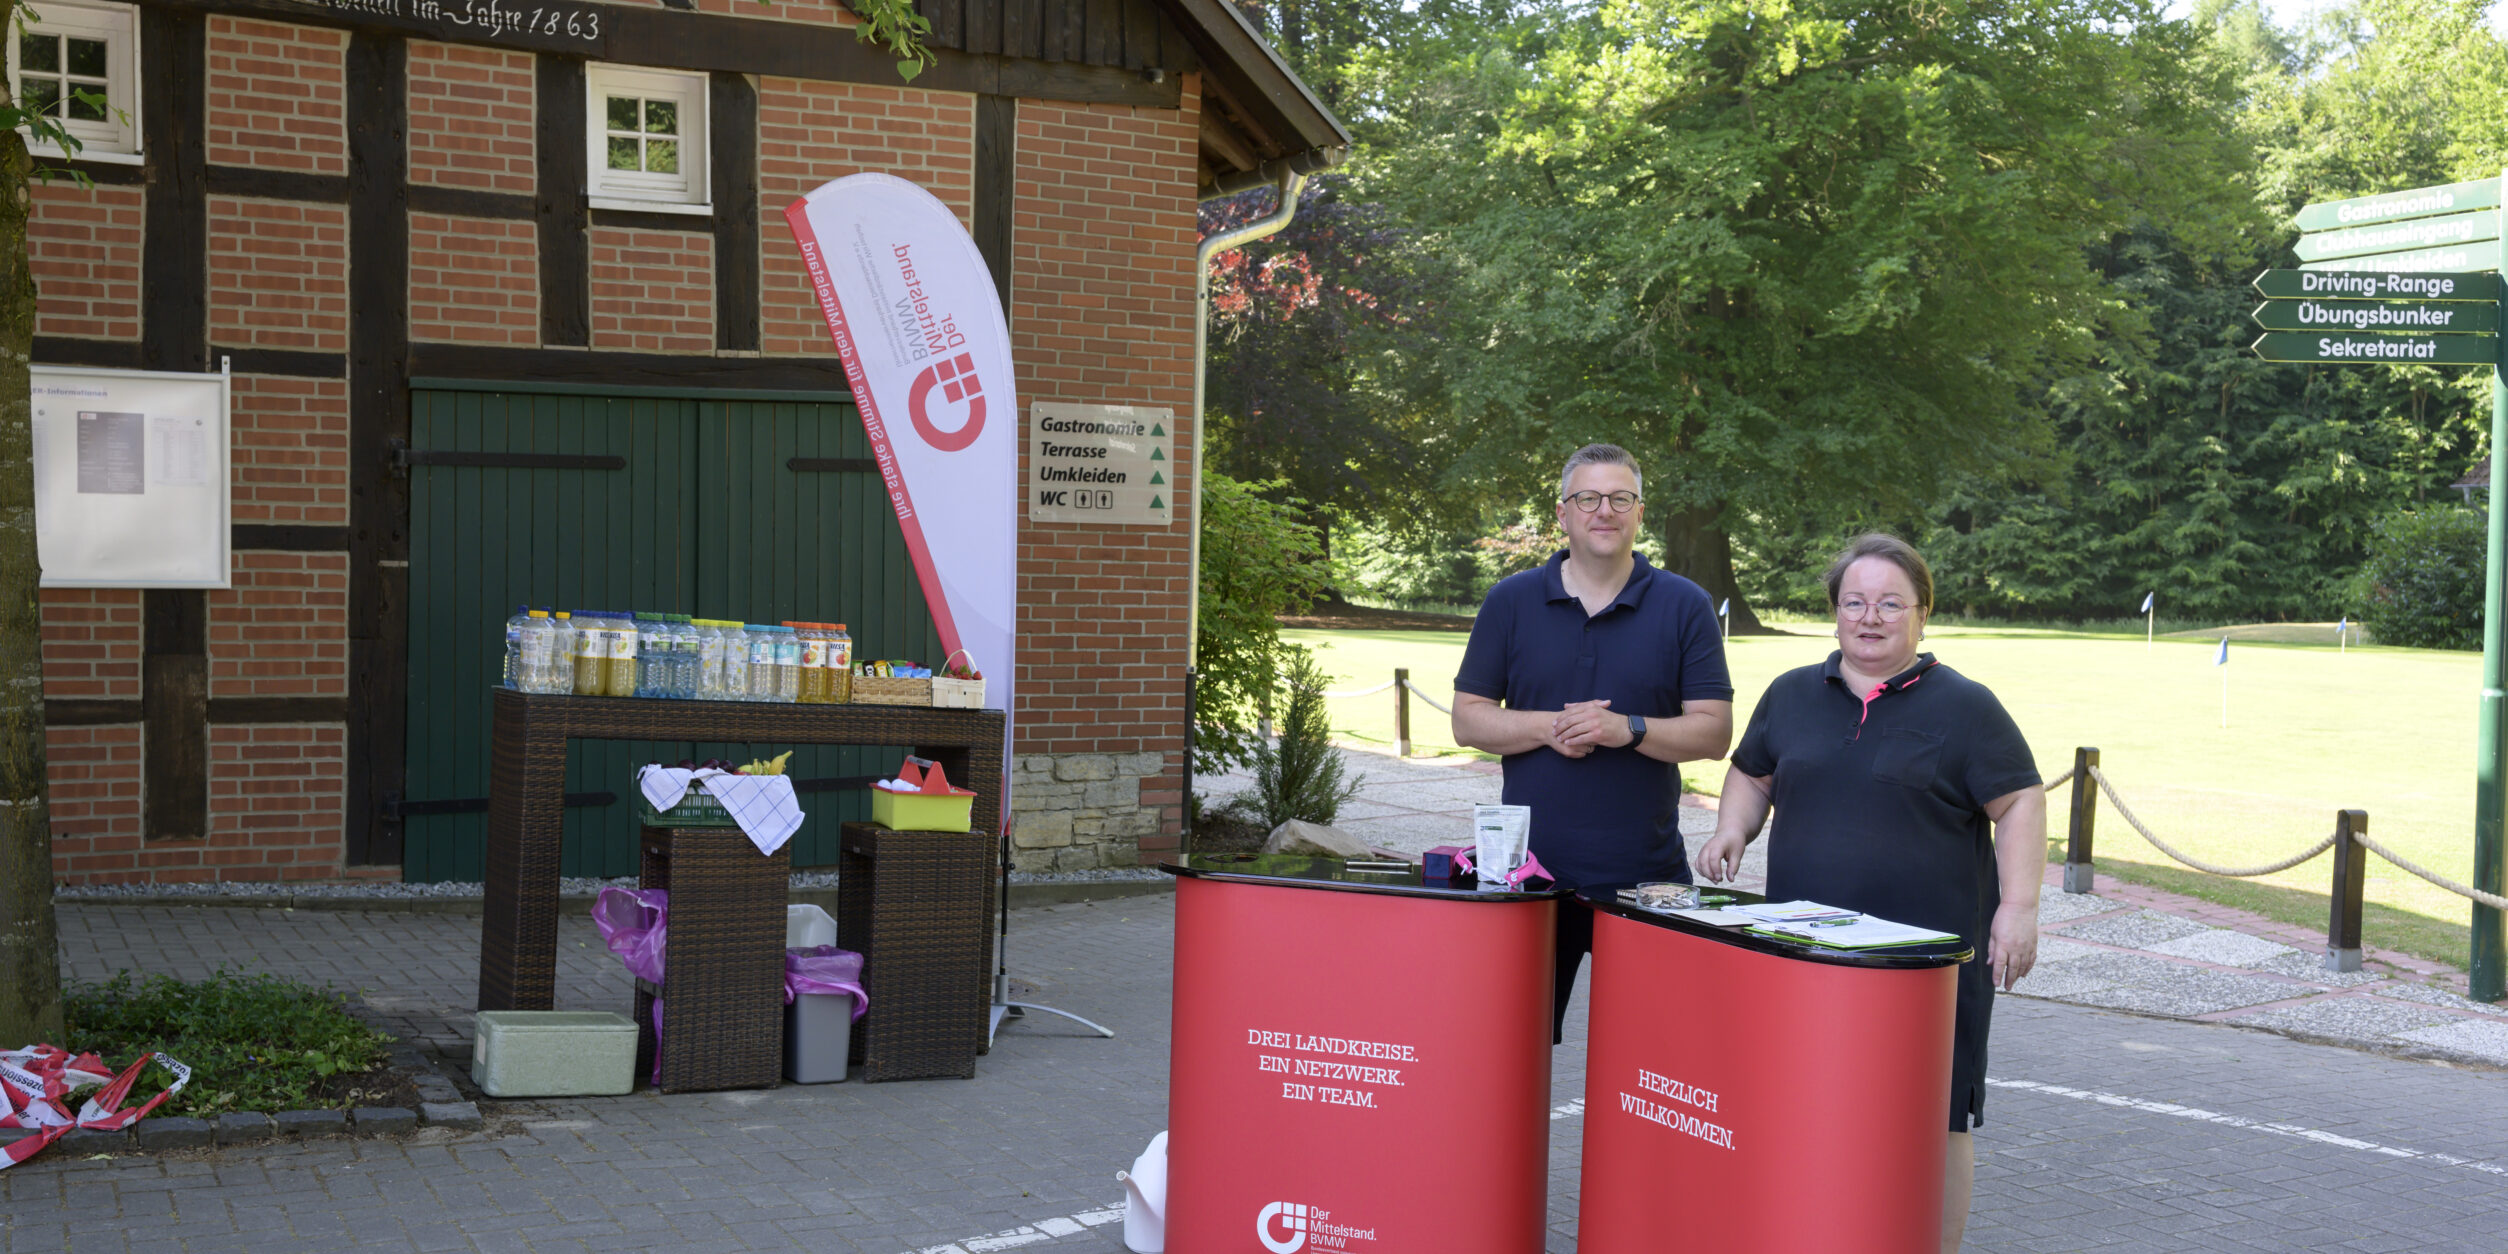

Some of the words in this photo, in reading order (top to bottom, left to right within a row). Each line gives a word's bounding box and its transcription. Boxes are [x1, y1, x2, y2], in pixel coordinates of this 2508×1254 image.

[528, 7, 599, 40] 1863
[2337, 190, 2454, 223] Gastronomie
[2316, 218, 2473, 254] Clubhauseingang
[2302, 272, 2454, 297] Driving-Range
[2298, 302, 2453, 329] Übungsbunker
[2319, 338, 2436, 359] Sekretariat
[1040, 417, 1145, 436] Gastronomie
[1040, 441, 1107, 458] Terrasse
[1040, 466, 1127, 483] Umkleiden
[1040, 491, 1068, 506] WC
[1247, 1029, 1291, 1048] DREI
[1295, 1034, 1419, 1063] LANDKREISE.
[1259, 1054, 1291, 1074] EIN
[1294, 1059, 1405, 1086] NETZWERK.
[1282, 1082, 1315, 1101] EIN
[1318, 1086, 1378, 1109] TEAM.
[1638, 1068, 1719, 1113] HERZLICH
[1620, 1091, 1736, 1151] WILLKOMMEN.
[1310, 1206, 1331, 1221] Der
[1310, 1219, 1377, 1241] Mittelstand.
[1310, 1234, 1347, 1249] BVMW
